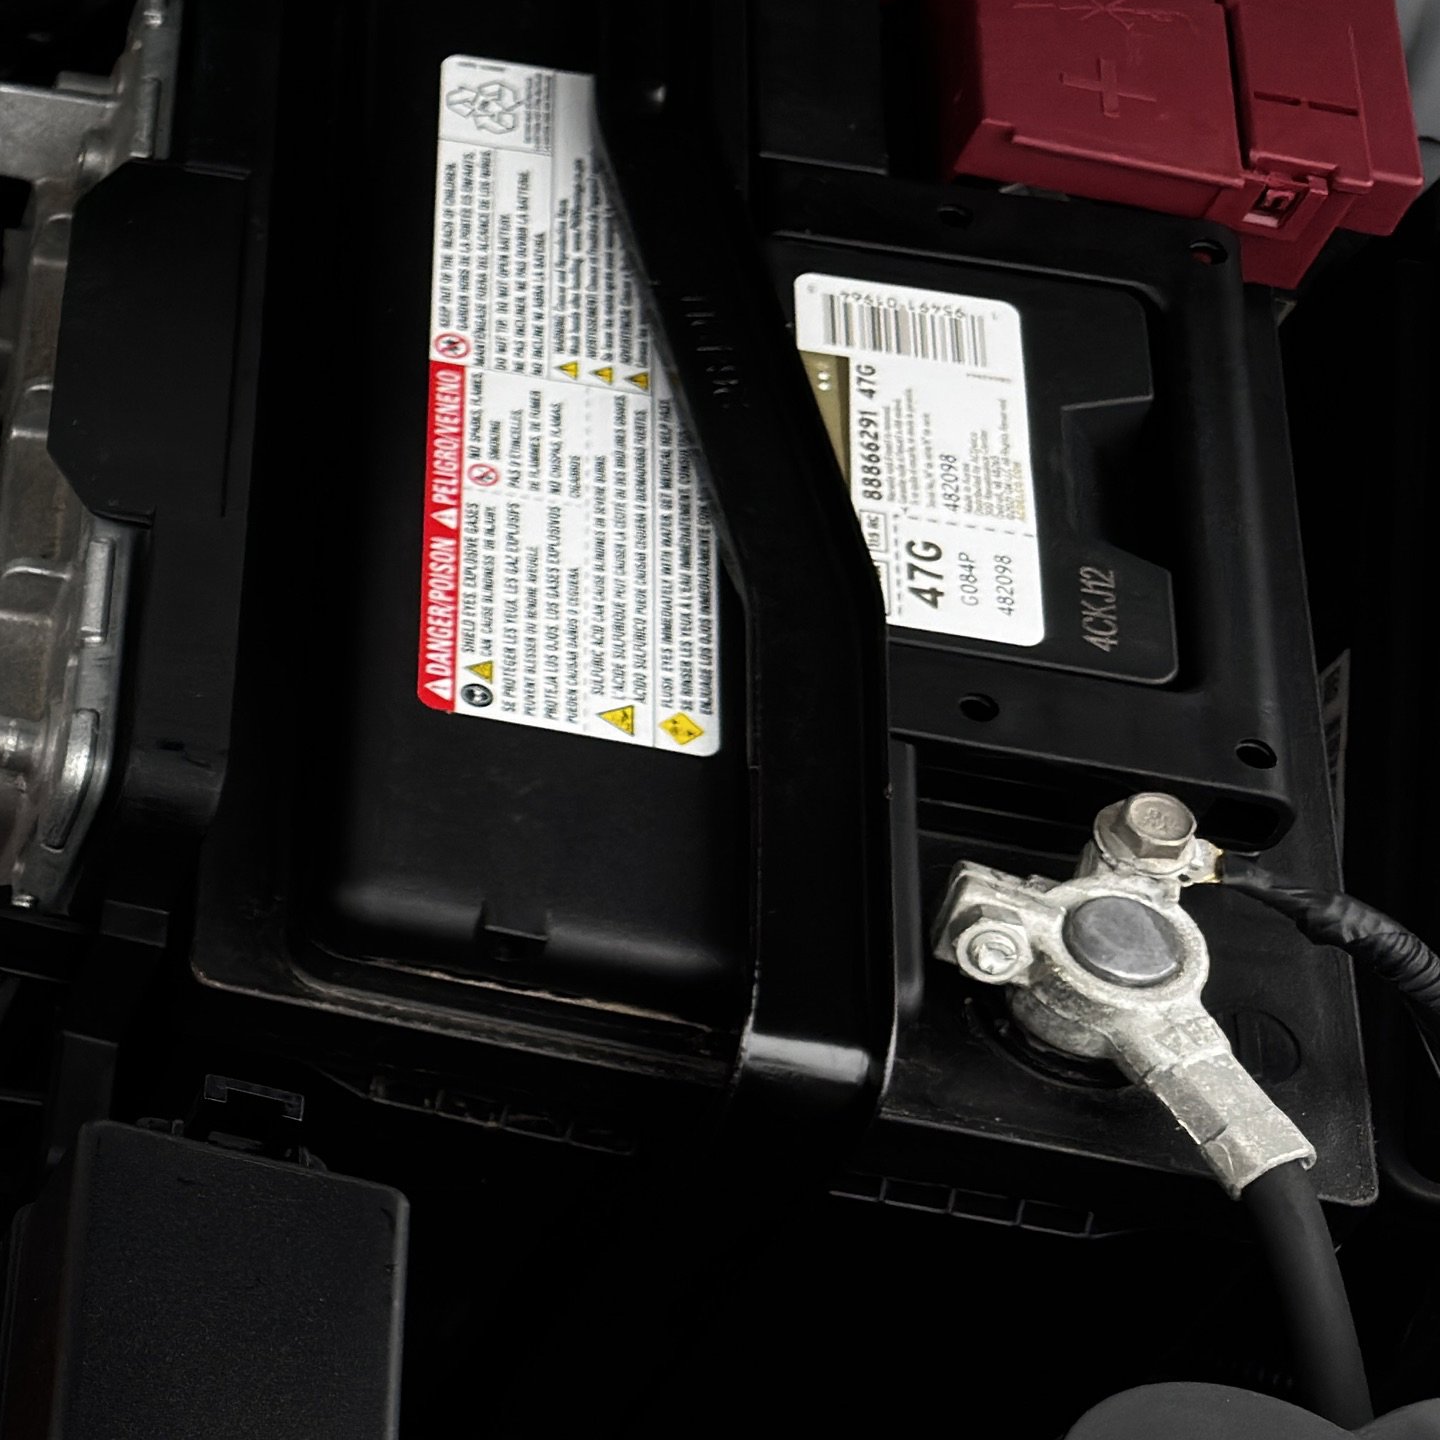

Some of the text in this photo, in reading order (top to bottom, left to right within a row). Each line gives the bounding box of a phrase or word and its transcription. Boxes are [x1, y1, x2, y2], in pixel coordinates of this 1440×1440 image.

[855, 363, 883, 501] 88866291 47G
[506, 468, 520, 488] PAS
[939, 454, 958, 511] 482098
[424, 366, 462, 678] DANGER/POISON PELIGRO/VENENO
[503, 500, 521, 553] EXPLOSIFS
[460, 501, 479, 654] SHIELD EXPLOSIVE GASES
[480, 553, 495, 604] BLINDNESS
[503, 553, 519, 575] GAZ
[907, 539, 943, 610] 47G
[956, 552, 979, 606] G084P
[503, 576, 519, 595] LES
[591, 573, 605, 602] CAUSE
[994, 554, 1015, 617] 482098
[479, 604, 493, 634] CAUSE
[541, 503, 562, 721] PROTEJA LOS LOS GASES EXPLOSIVOS
[591, 602, 605, 623] CAN
[1079, 565, 1119, 652] 4CKJ12
[479, 637, 492, 658] CAN
[502, 626, 517, 645] LES
[590, 623, 605, 648] ACID
[610, 600, 626, 660] SULFURIQUE
[563, 649, 579, 687] CAUSAR
[589, 648, 605, 696] SULFURIC
[658, 646, 672, 672] EYES
[521, 675, 537, 717] PEUVENT
[563, 686, 579, 724] PUEDEN
[658, 675, 673, 709] FLUSH
